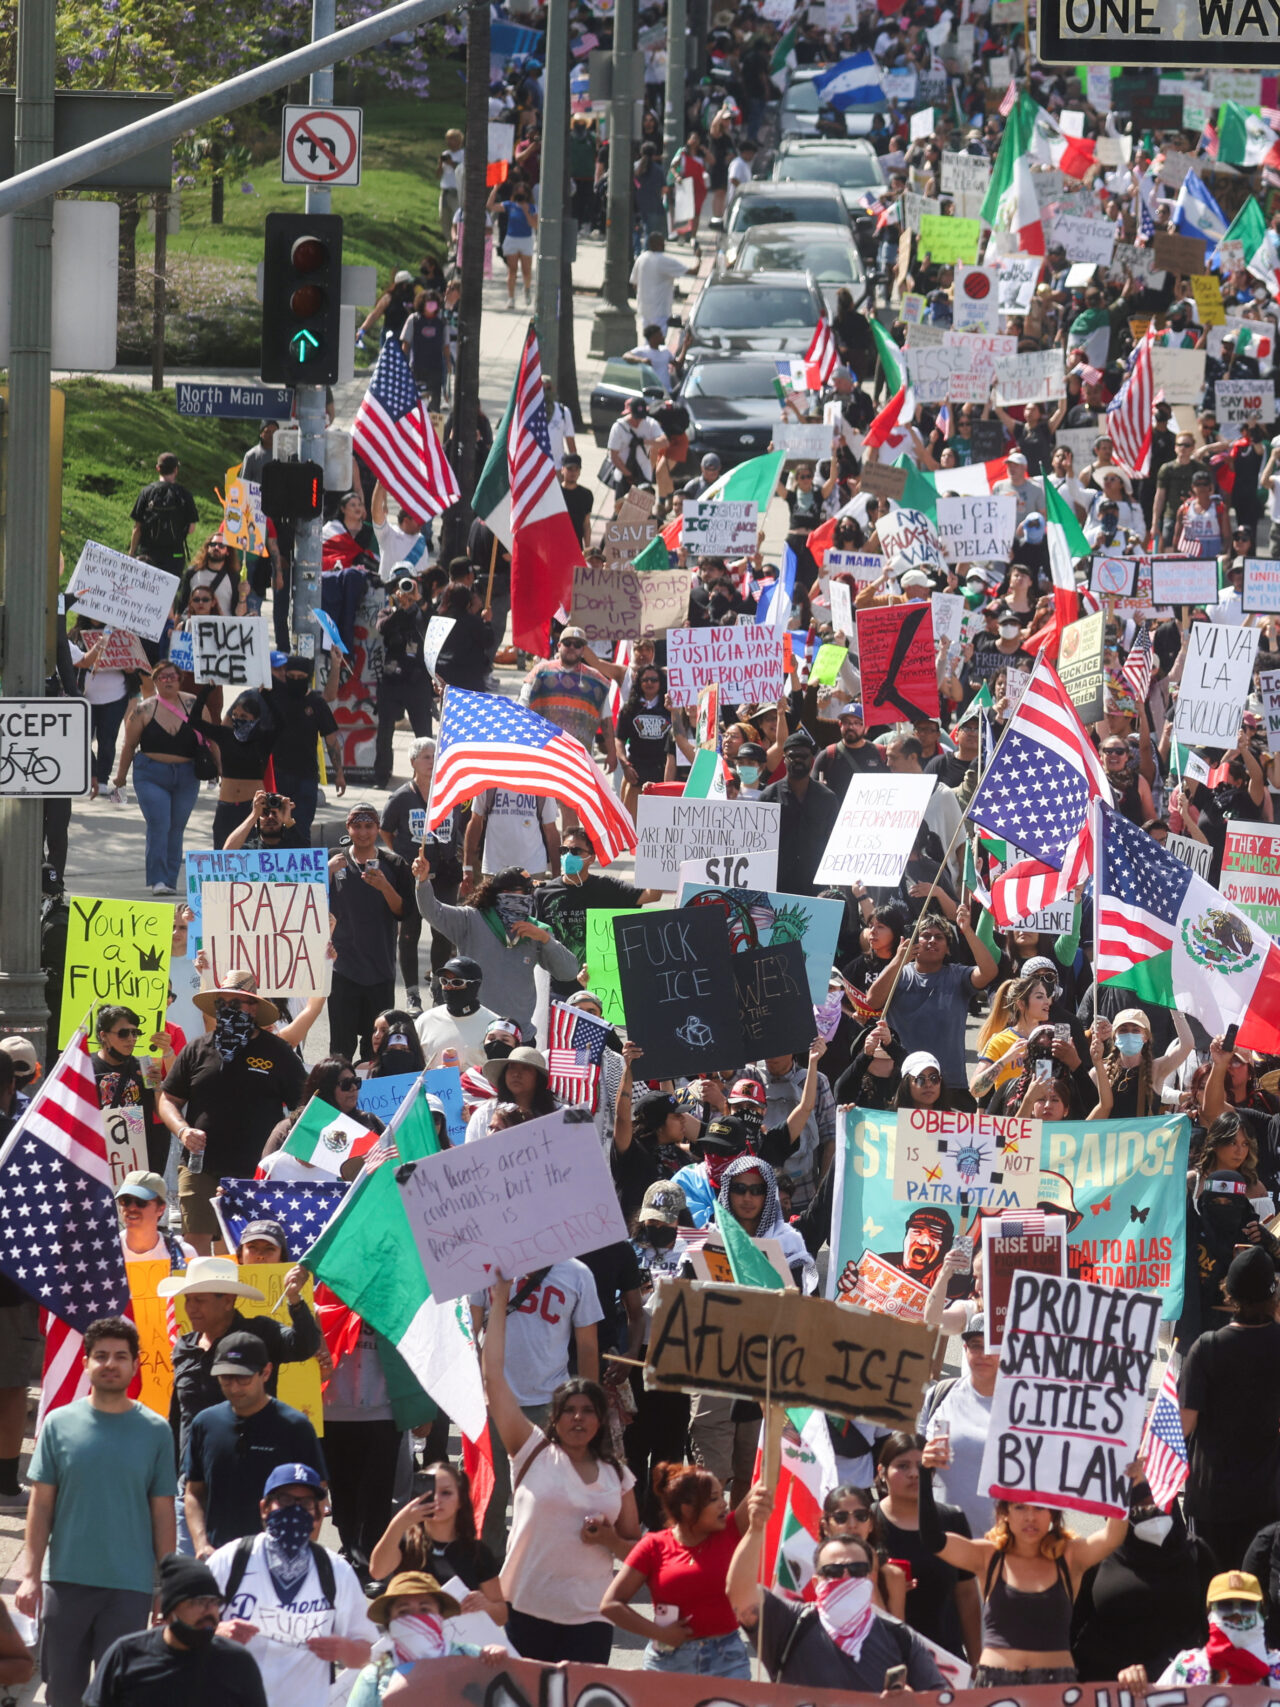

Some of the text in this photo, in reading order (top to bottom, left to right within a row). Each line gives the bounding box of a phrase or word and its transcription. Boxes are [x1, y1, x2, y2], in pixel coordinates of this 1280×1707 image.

[1065, 0, 1160, 35] ONE
[180, 401, 212, 414] 200 N
[181, 385, 288, 406] North Main St
[1221, 396, 1262, 409] SAY NO
[608, 526, 655, 541] SAVE
[829, 553, 881, 567] MI MAMA
[198, 622, 254, 656] FUCK
[672, 625, 775, 646] SI NO HAY
[1195, 626, 1252, 663] VIVA
[669, 641, 783, 665] JUSTICIA PARA
[1083, 658, 1099, 673] ICE
[200, 654, 247, 684] ICE
[668, 668, 690, 687] EL
[1201, 662, 1232, 690] LA
[672, 806, 779, 834] IMMIGRANTS
[665, 828, 685, 845] NOT
[741, 832, 767, 849] JOBS
[1228, 834, 1265, 855] THEY
[188, 853, 250, 874] THEY
[230, 882, 322, 935] RAZA
[1239, 886, 1256, 903] YOU
[72, 900, 159, 942] You're
[103, 945, 126, 963] a
[622, 921, 698, 969] FUCK
[211, 933, 316, 991] UNIDA
[656, 968, 712, 1003] ICE
[910, 1109, 1033, 1140] OBEDIENCE
[413, 1169, 441, 1200] My
[498, 1129, 553, 1172] aren't
[907, 1146, 1035, 1173] IS NOT
[423, 1163, 574, 1227] criminals, but the
[502, 1207, 519, 1224] is
[492, 1202, 619, 1274] DICTATOR
[994, 1235, 1058, 1254] RISE UP!
[1012, 1275, 1163, 1355] PROTECT
[1001, 1332, 1155, 1396] SANCTUARY
[1008, 1379, 1127, 1435] CITIES
[998, 1433, 1134, 1507] BY LAW
